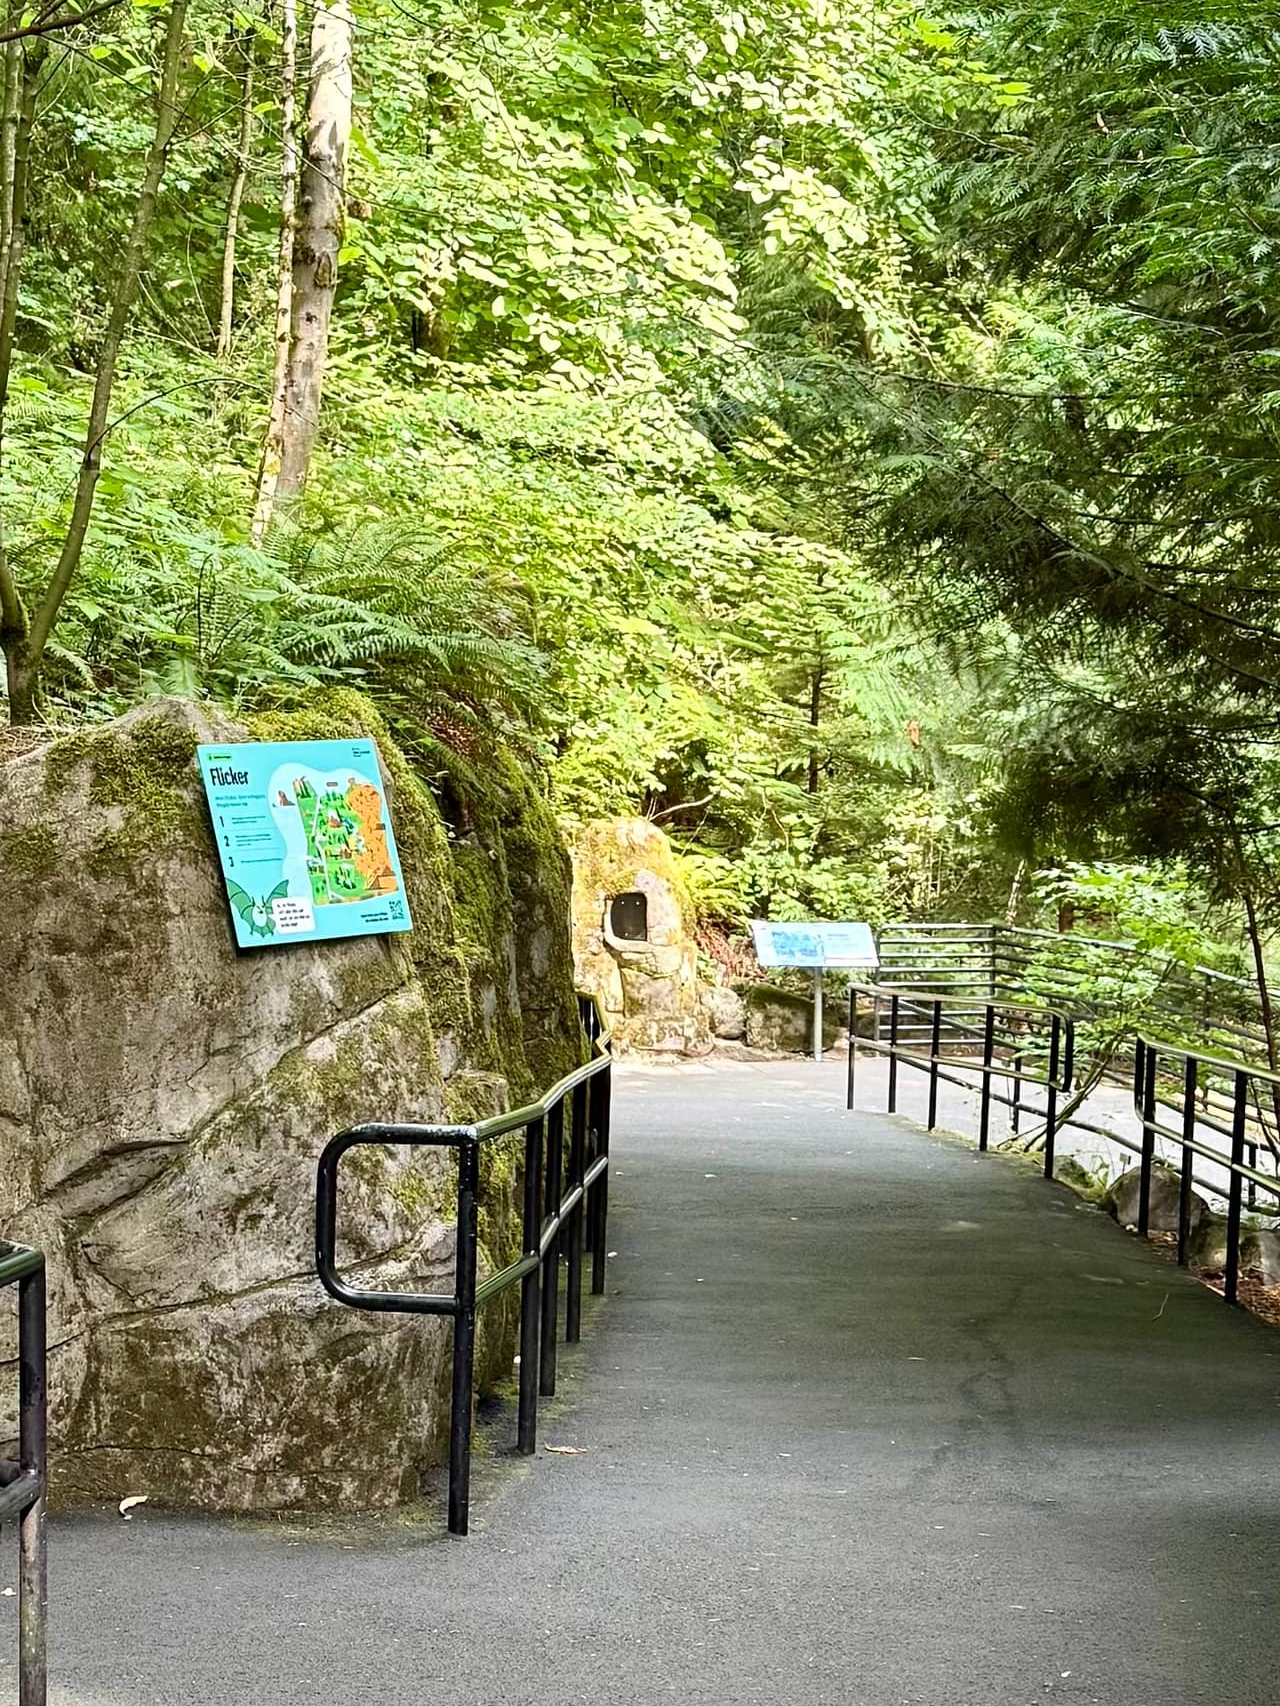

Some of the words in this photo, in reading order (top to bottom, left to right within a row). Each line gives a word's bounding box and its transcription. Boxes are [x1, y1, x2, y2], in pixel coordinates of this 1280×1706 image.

[209, 766, 249, 787] Flicker
[219, 815, 225, 828] 1
[223, 835, 231, 847] 2
[228, 856, 235, 868] 3
